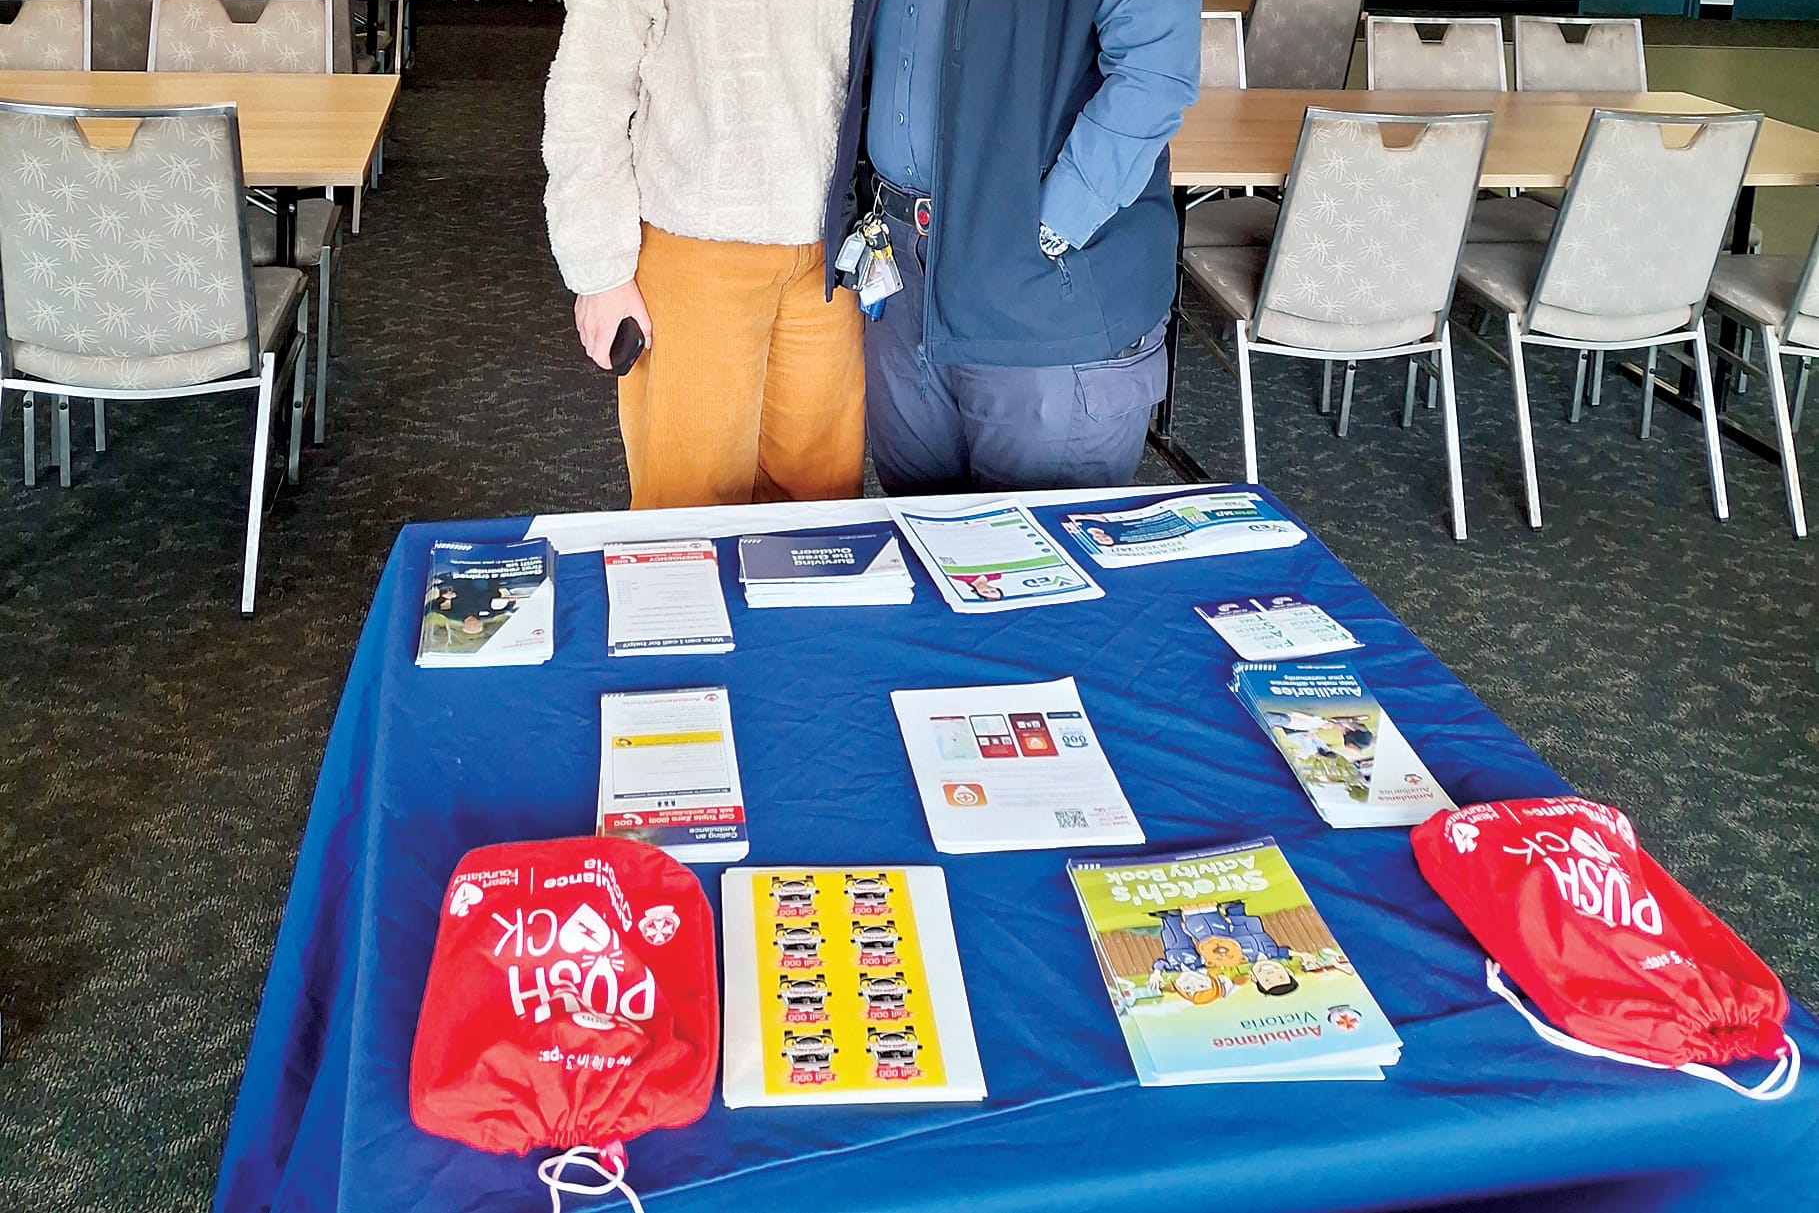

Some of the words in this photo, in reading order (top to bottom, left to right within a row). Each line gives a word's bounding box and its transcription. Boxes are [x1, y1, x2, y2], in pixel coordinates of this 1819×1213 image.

[790, 547, 852, 555] Outdoors
[793, 558, 855, 566] Surviving
[1269, 686, 1362, 699] Auxiliaries
[1377, 791, 1434, 806] Ambulance
[693, 814, 718, 822] Triple
[689, 826, 737, 835] Ambulance
[708, 831, 738, 839] Calling
[1169, 854, 1255, 879] Activity
[482, 876, 518, 888] Heart
[1104, 868, 1168, 887] Book
[1110, 869, 1268, 906] Stretch's
[1543, 856, 1663, 935] PUSH
[508, 956, 656, 1023] PUSH
[1240, 1010, 1318, 1031] Victoria
[1212, 1025, 1322, 1049] Ambulance
